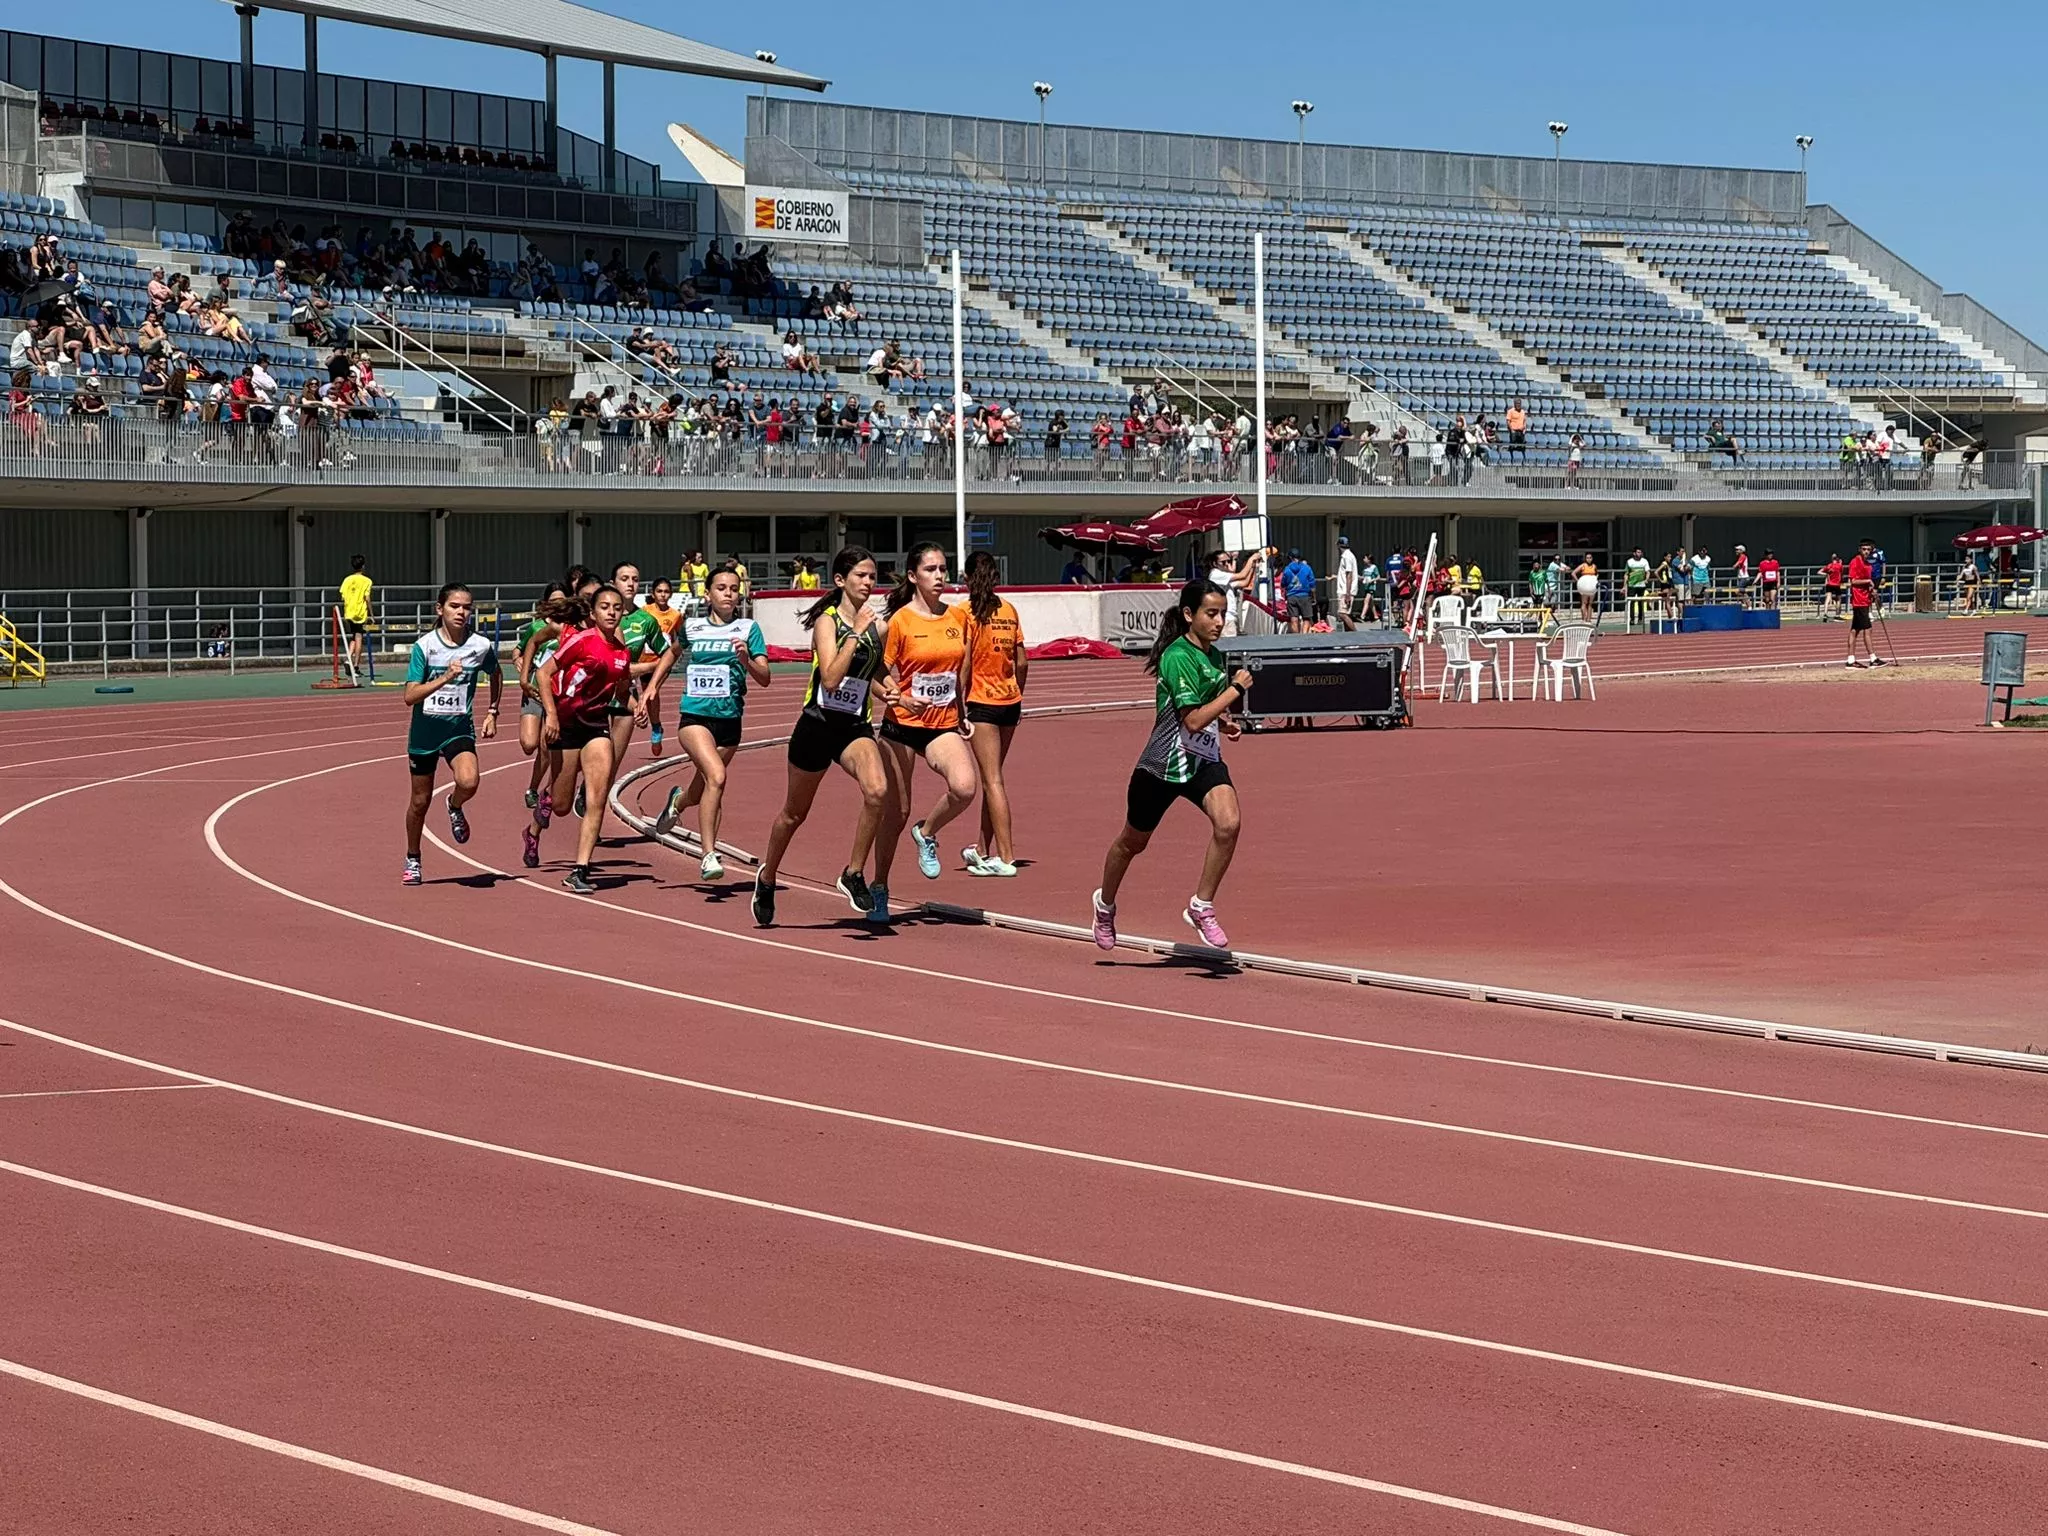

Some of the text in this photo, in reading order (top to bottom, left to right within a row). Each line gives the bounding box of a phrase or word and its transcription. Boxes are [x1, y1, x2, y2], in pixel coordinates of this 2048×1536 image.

[776, 199, 834, 217] GOBIERNO
[776, 216, 840, 233] DE ARAGON
[1120, 611, 1157, 630] TOKYO
[692, 677, 724, 688] 1872
[918, 684, 950, 697] 1698
[430, 696, 460, 706] 1641
[826, 689, 859, 705] 1892
